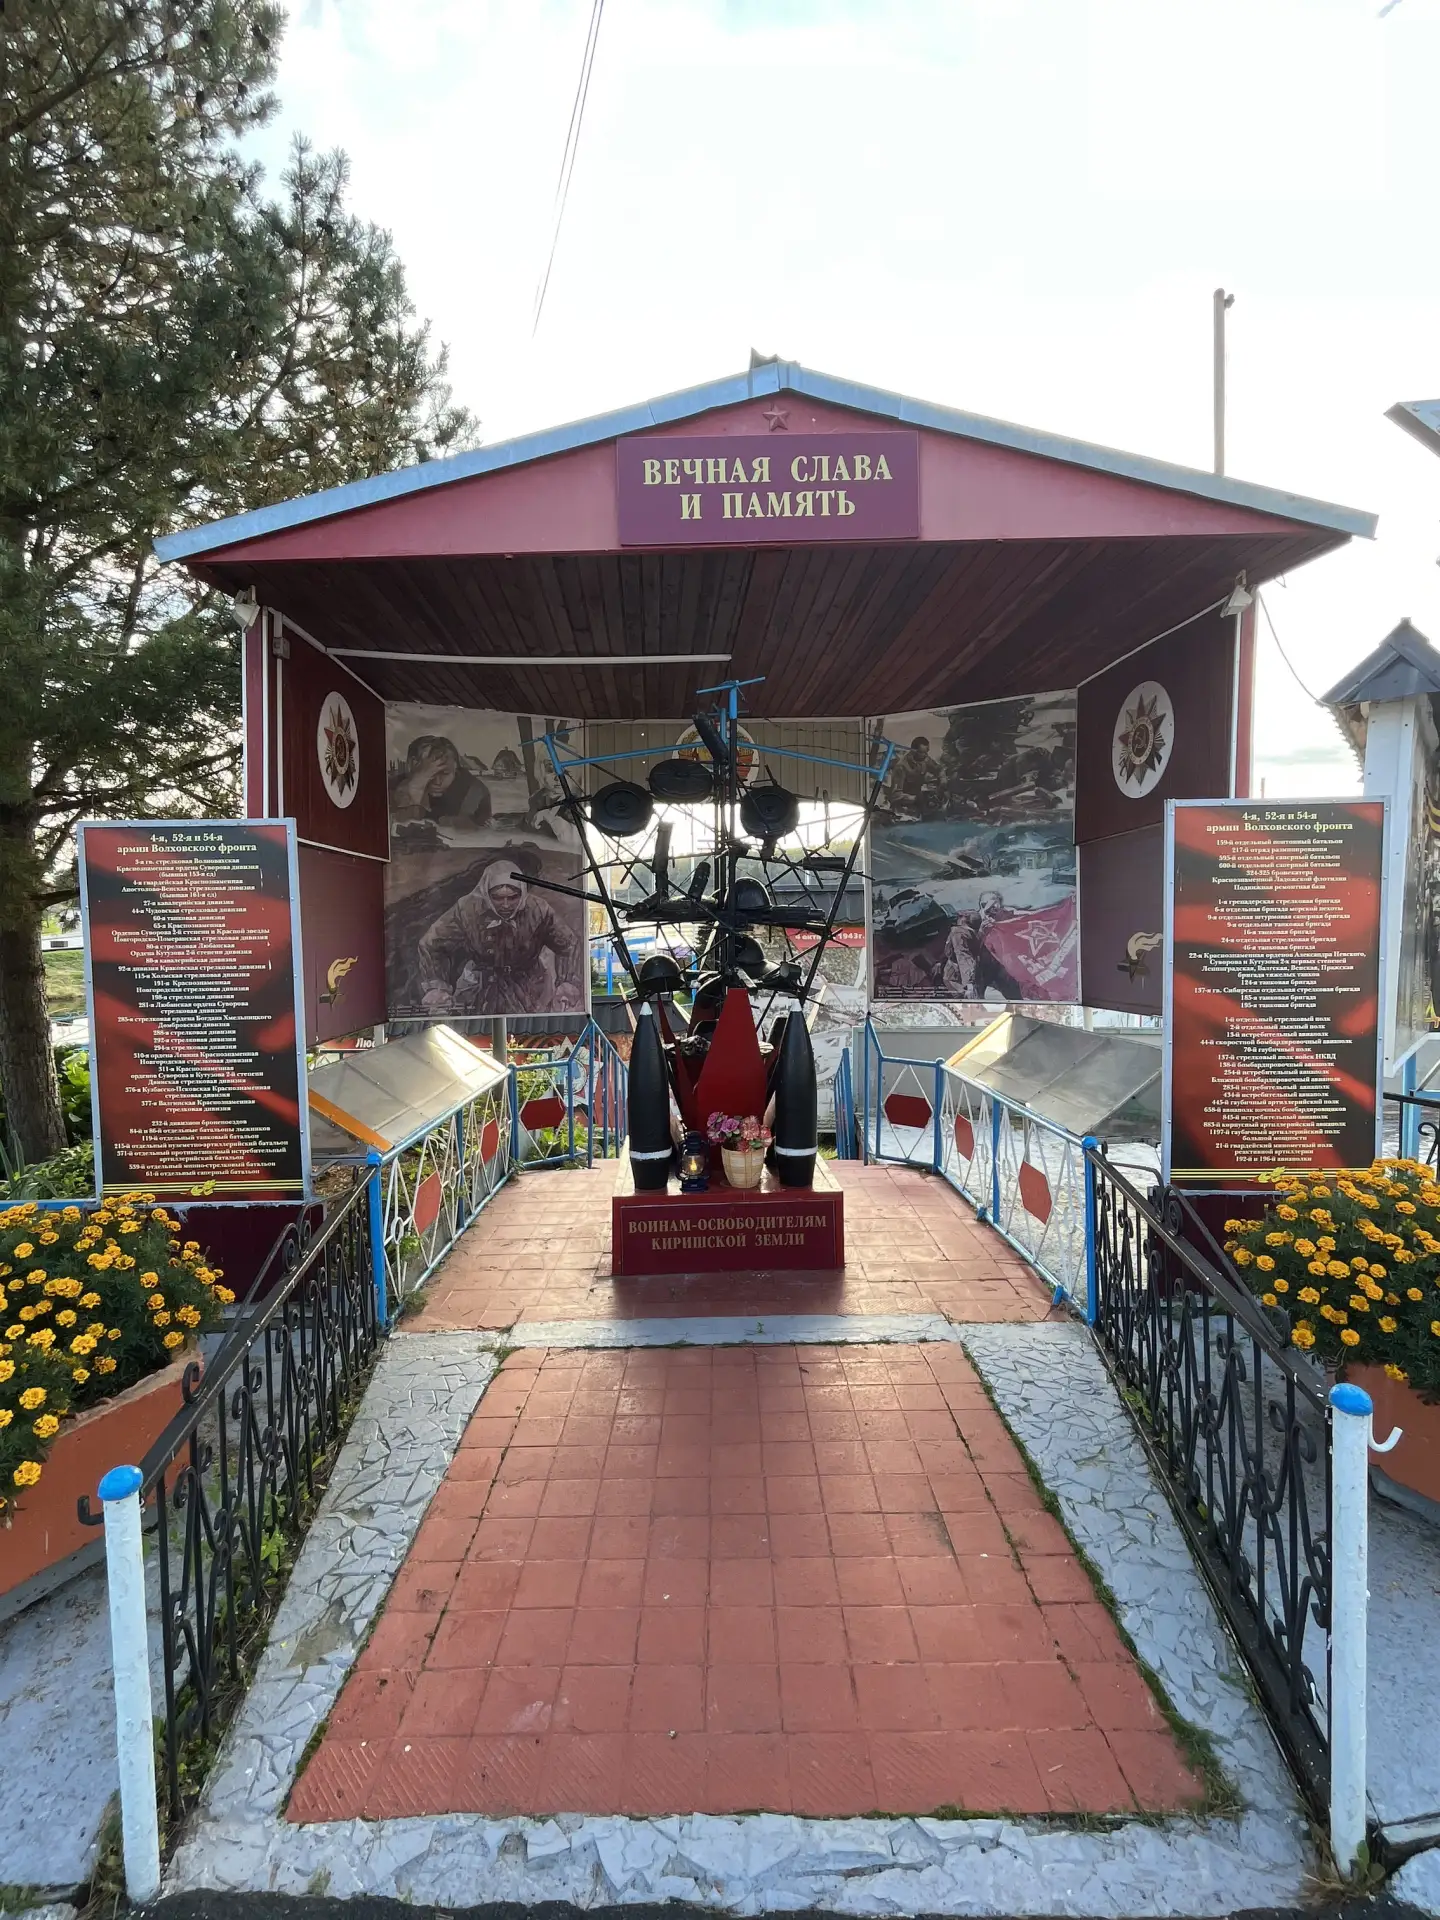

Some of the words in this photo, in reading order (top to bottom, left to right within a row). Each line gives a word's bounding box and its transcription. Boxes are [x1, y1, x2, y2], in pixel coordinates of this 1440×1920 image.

[642, 457, 771, 485] ВЕЧНАЯ
[790, 454, 893, 482] СЛАВА
[679, 493, 702, 520] И
[722, 490, 856, 519] ПАМЯТЬ
[1242, 813, 1260, 822] 4-я,
[1206, 825, 1240, 834] армии
[1244, 823, 1311, 832] Волховского
[1312, 822, 1353, 833] фронта
[150, 834, 168, 843] 4-я,
[117, 846, 149, 855] армии
[218, 843, 257, 854] фронта
[628, 1215, 827, 1233] ВОИНАМ-ОСВОБОДИТЕЛЯМ
[652, 1234, 746, 1250] КИРИШСКОЙ
[755, 1233, 805, 1247] ЗЕМЛИ
